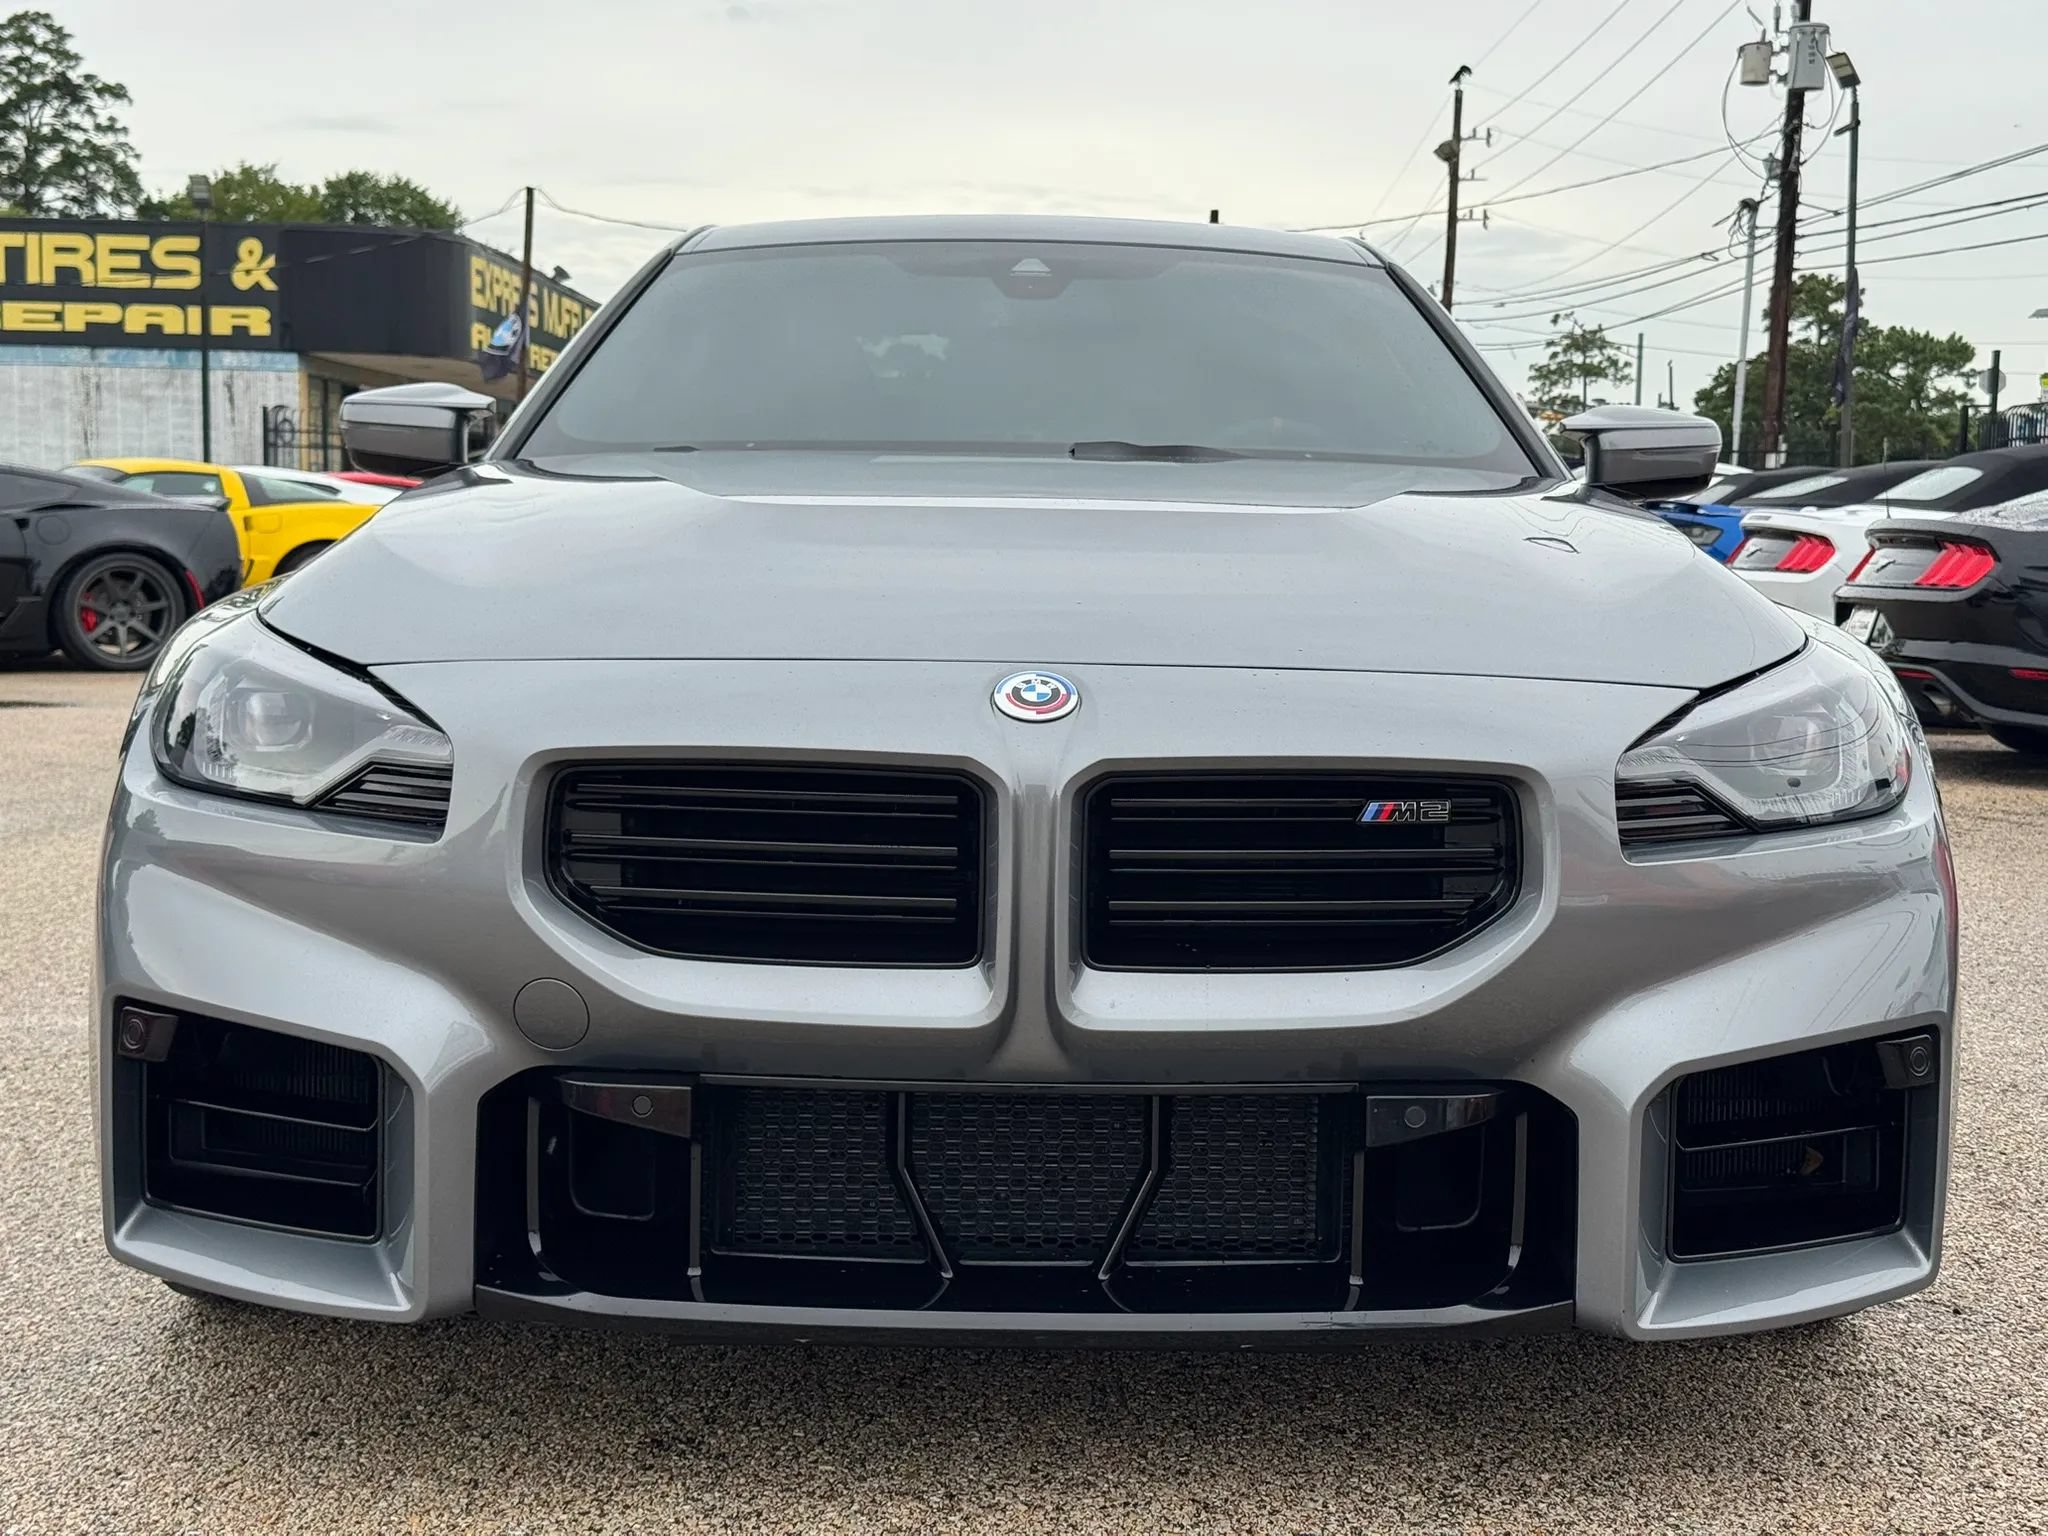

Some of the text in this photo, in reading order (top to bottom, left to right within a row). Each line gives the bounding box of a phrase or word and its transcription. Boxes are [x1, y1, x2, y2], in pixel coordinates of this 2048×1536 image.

[231, 236, 280, 291] &
[0, 301, 272, 337] EPAIR
[471, 255, 539, 328] EXPRES
[543, 286, 593, 339] MUFF
[1390, 801, 1450, 822] M2
